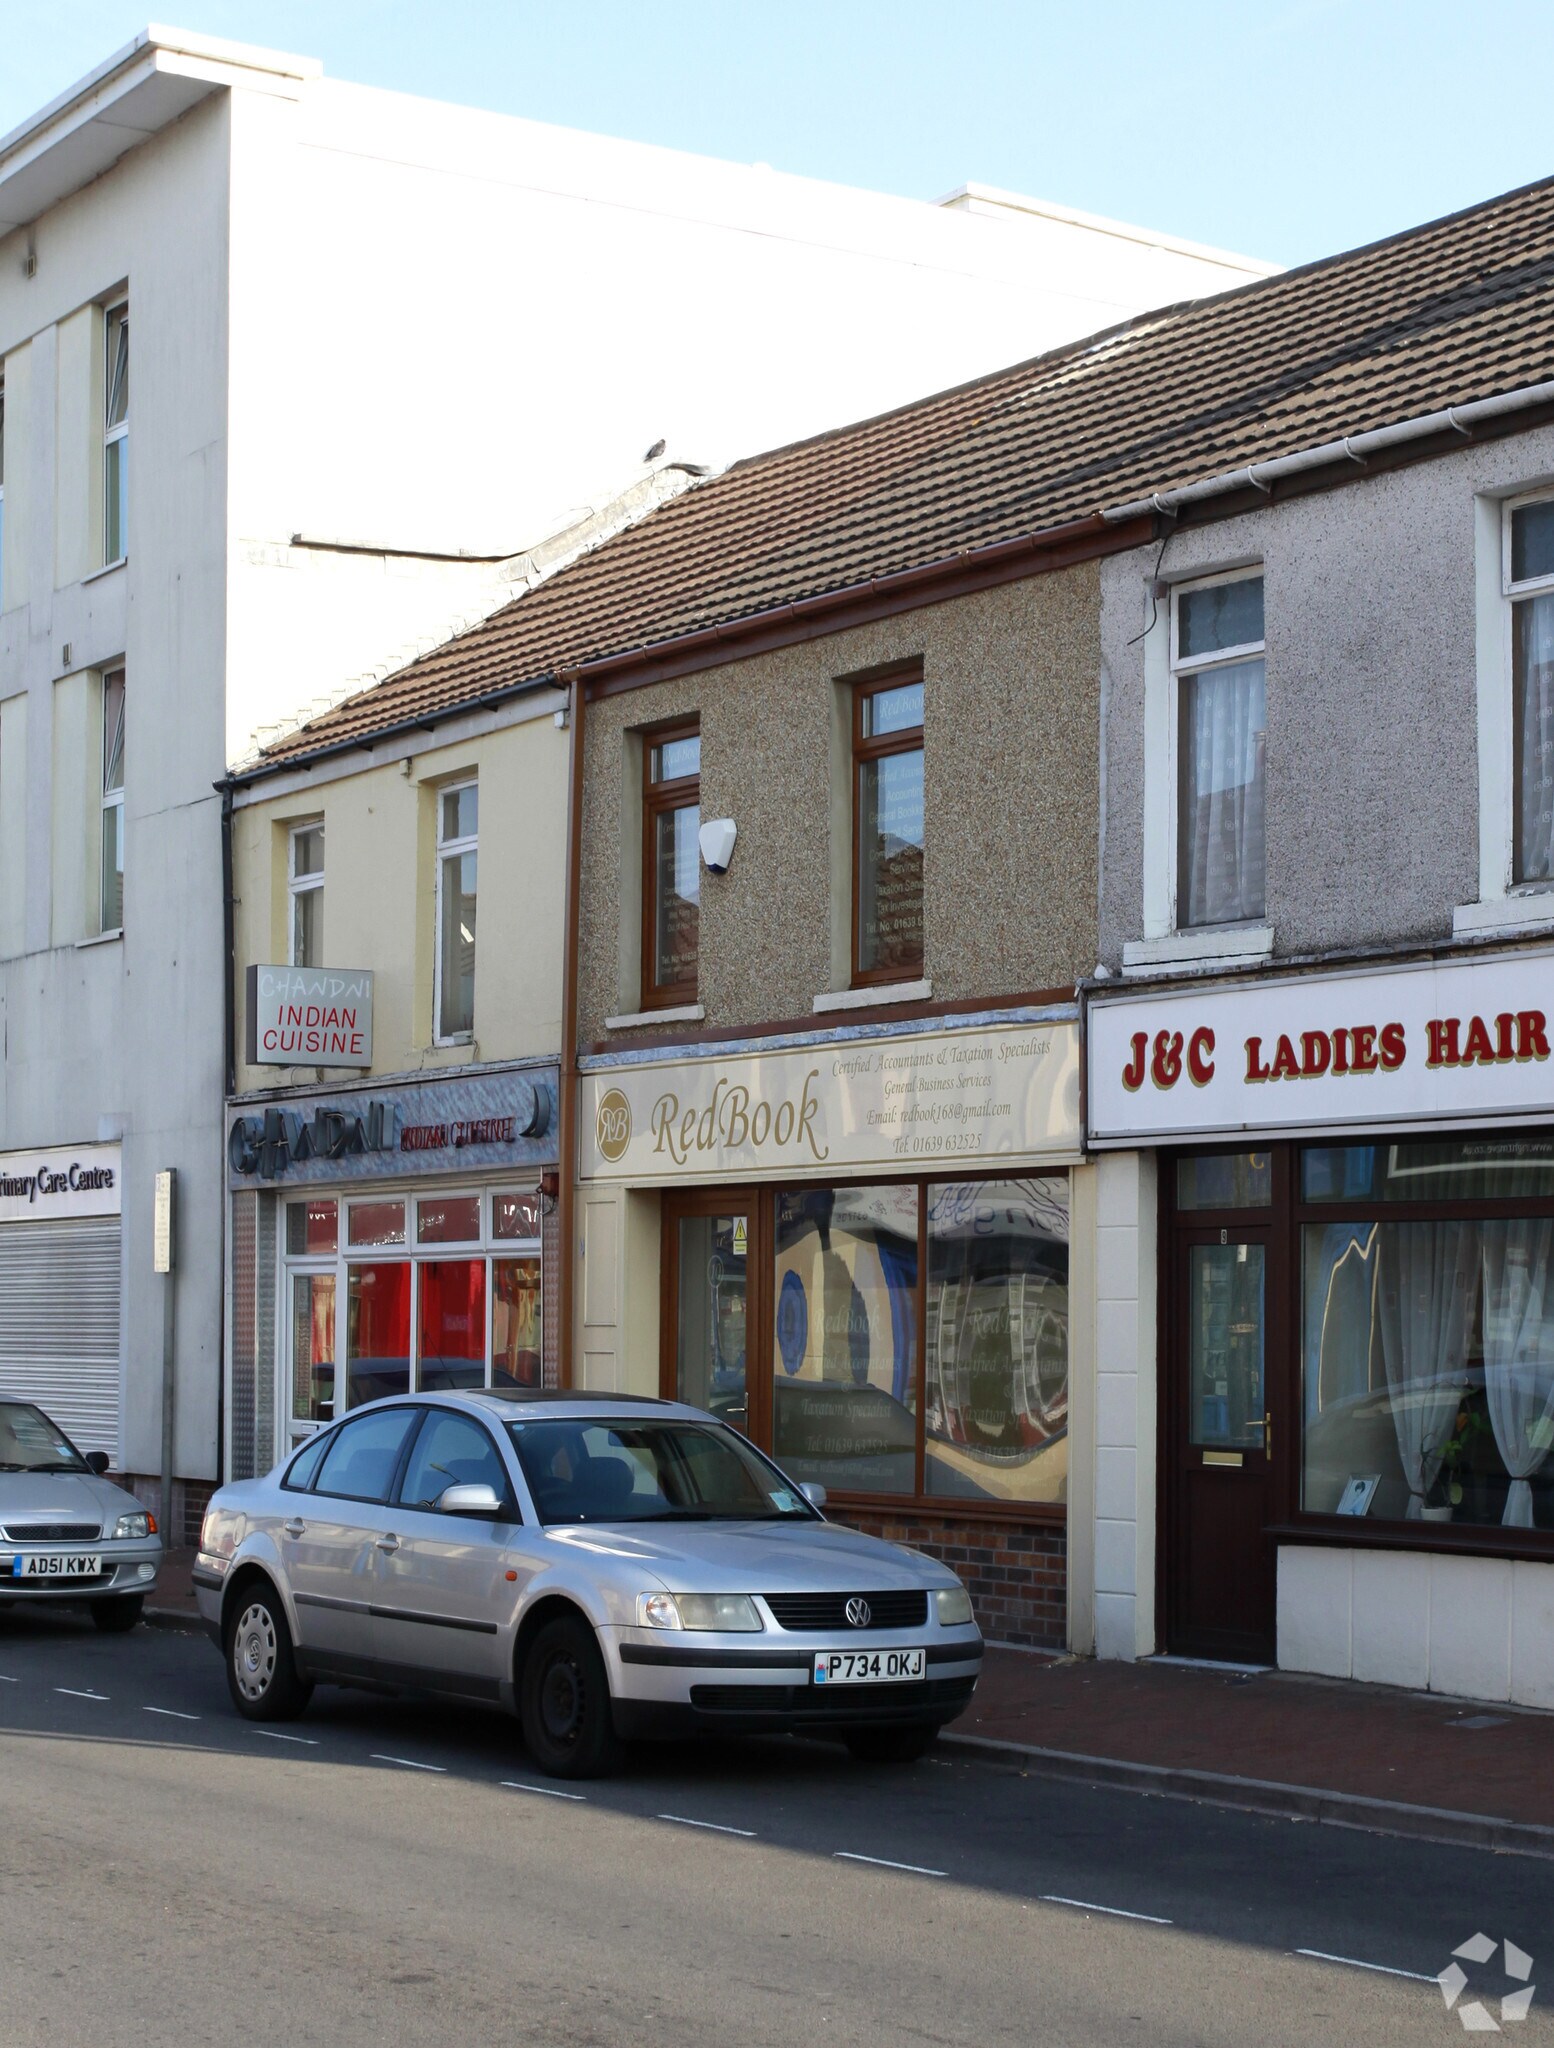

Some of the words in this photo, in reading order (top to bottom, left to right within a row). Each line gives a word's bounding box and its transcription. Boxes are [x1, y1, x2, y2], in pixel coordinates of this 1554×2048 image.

[889, 862, 920, 875] Services
[874, 883, 903, 898] Taxation
[877, 902, 888, 916] Tax
[894, 916, 916, 930] 01639
[260, 973, 370, 1000] CHANDNI
[278, 1005, 356, 1028] INDIAN
[263, 1029, 364, 1054] CUISINE
[1122, 1026, 1216, 1092] J&C
[1244, 1023, 1407, 1084] LADIES
[1425, 1010, 1552, 1069] HAIR
[832, 1055, 872, 1079] Certified
[875, 1051, 934, 1073] Accountants
[937, 1045, 948, 1065] &
[950, 1044, 993, 1065] Taxation
[998, 1037, 1051, 1064] Specialists
[885, 1075, 917, 1099] General
[917, 1075, 955, 1093] Business
[956, 1072, 992, 1090] Services
[652, 1069, 829, 1165] RedBook
[866, 1106, 897, 1126] Email:
[900, 1099, 1012, 1125] redbook168@gmail.com
[401, 1125, 448, 1152] INDIAN
[451, 1117, 517, 1148] CUISINE
[913, 1136, 943, 1153] 01639
[945, 1133, 983, 1151] 632525
[38, 1166, 68, 1193] Care
[69, 1163, 114, 1191] Centre
[825, 1437, 852, 1453] 01639
[28, 1557, 62, 1574] AD51
[66, 1557, 96, 1573] KWX
[829, 1655, 881, 1678] P734
[887, 1653, 922, 1676] OKJ
